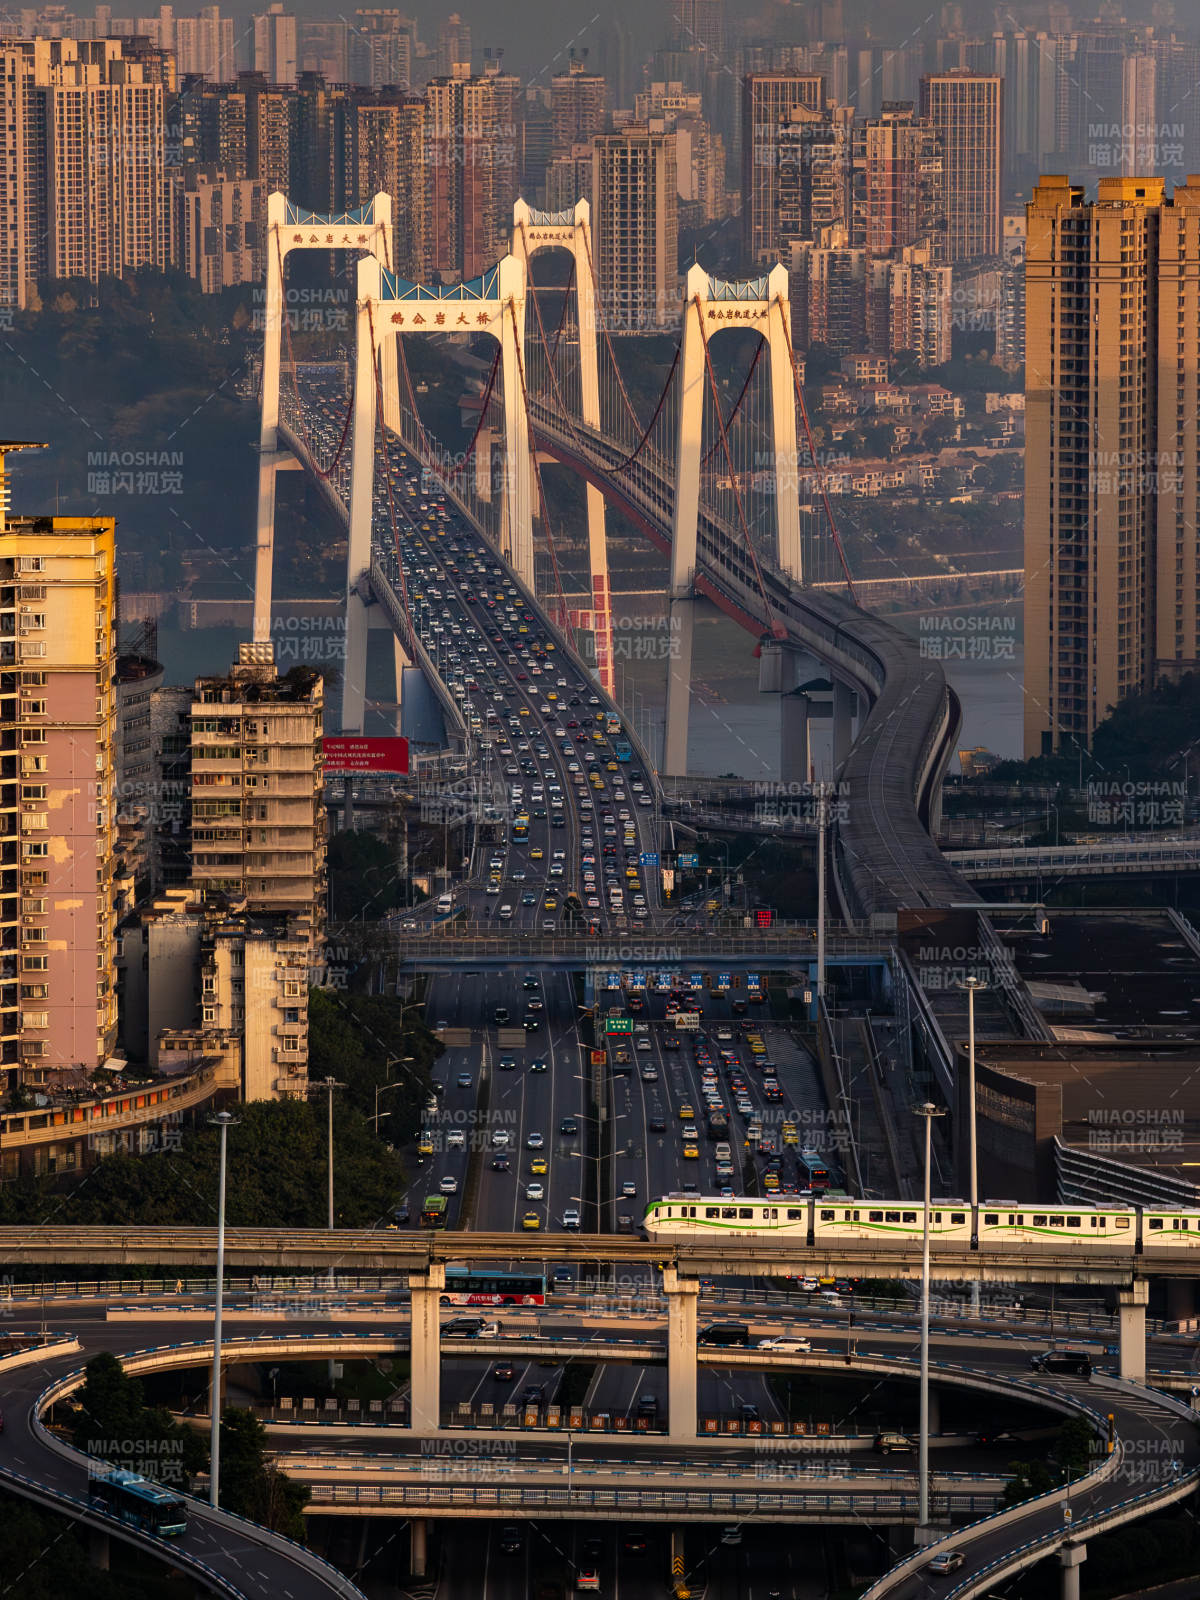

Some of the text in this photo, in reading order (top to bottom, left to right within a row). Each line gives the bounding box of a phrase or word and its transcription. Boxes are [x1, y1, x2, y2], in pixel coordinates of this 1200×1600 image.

[293, 233, 368, 244] 鹅公岩大桥
[391, 312, 491, 325] 鹅公岩大桥
[708, 309, 768, 320] 鹅公岩轨道大桥
